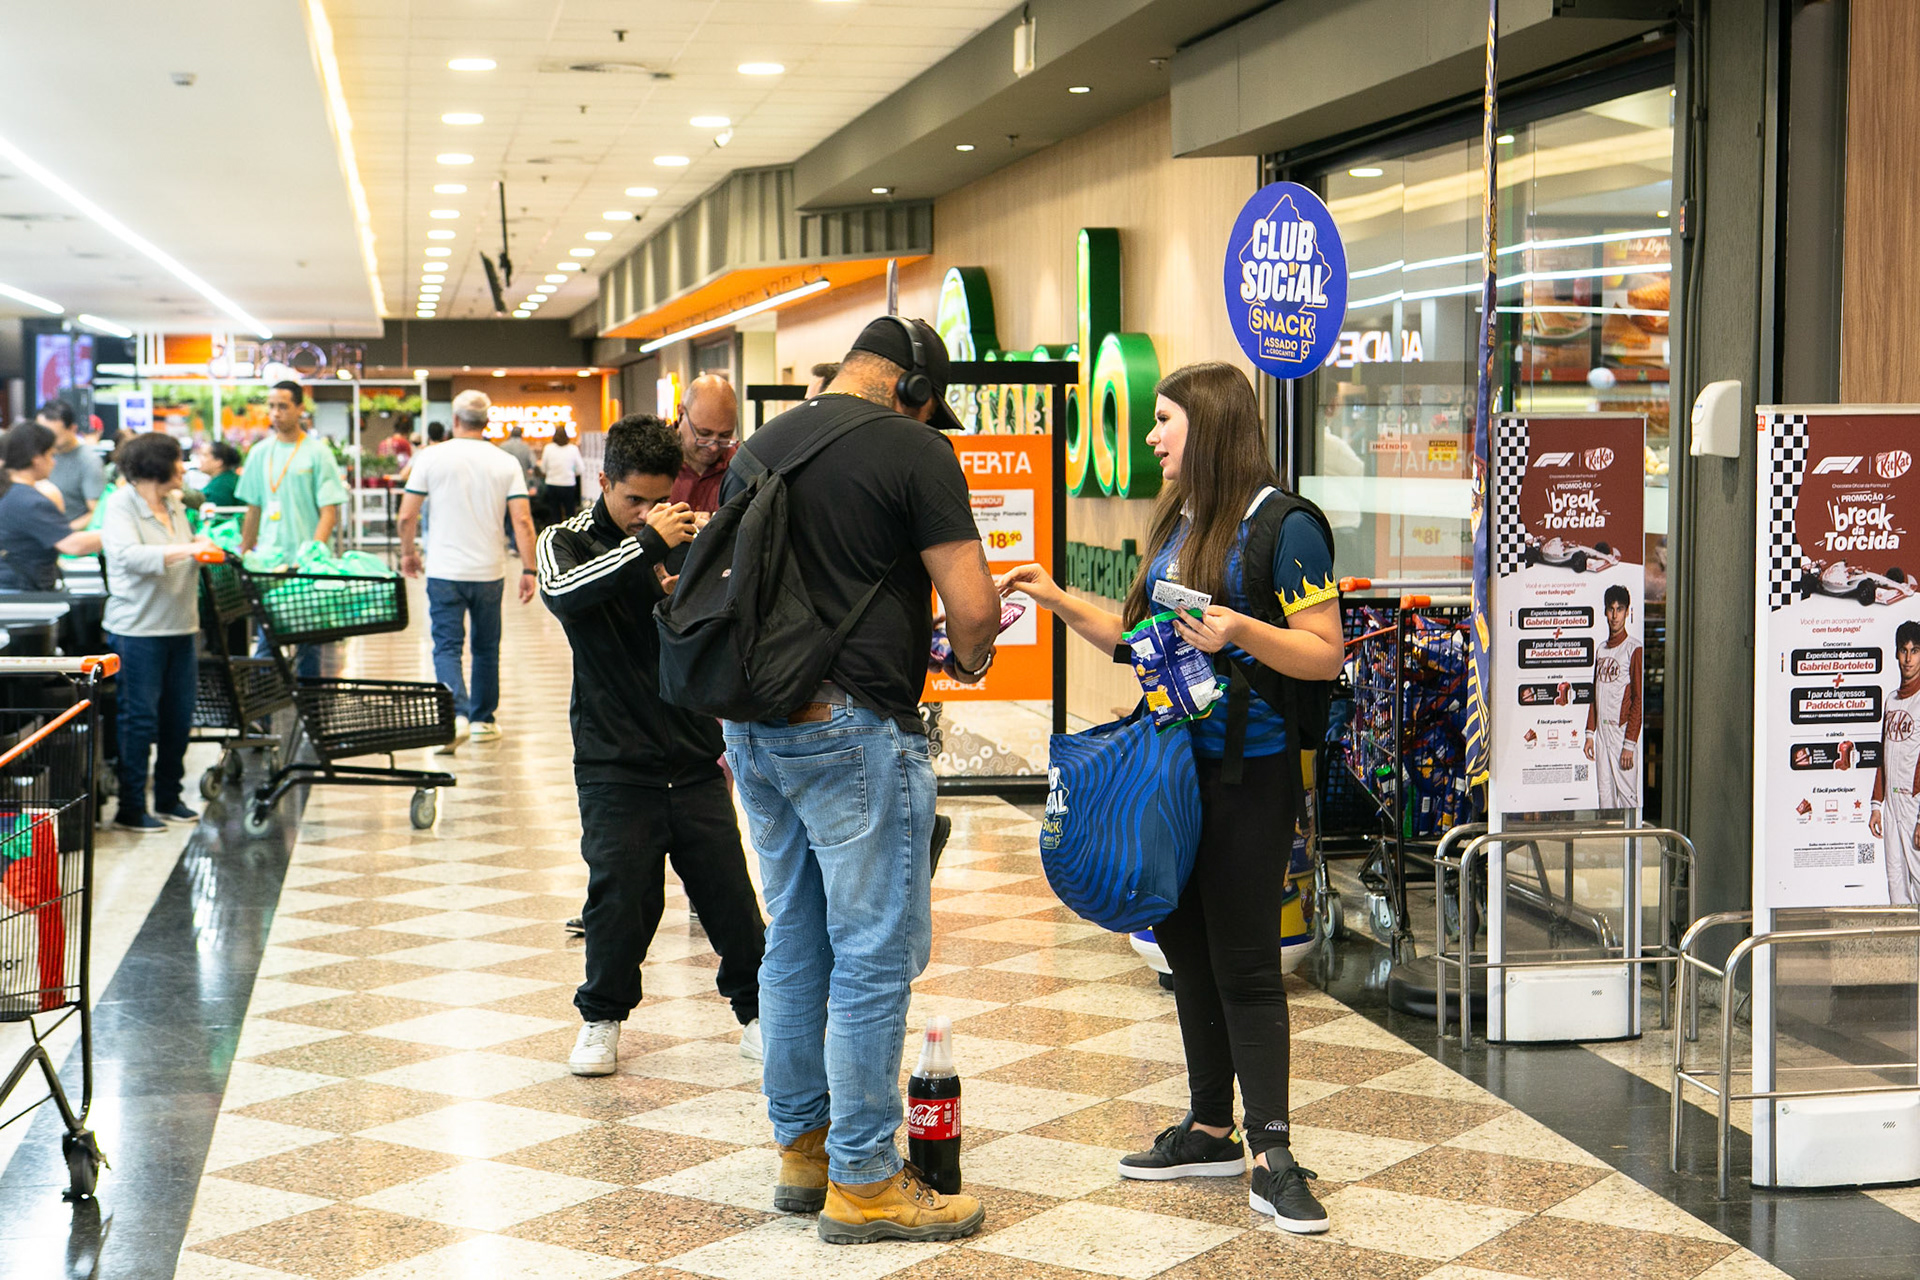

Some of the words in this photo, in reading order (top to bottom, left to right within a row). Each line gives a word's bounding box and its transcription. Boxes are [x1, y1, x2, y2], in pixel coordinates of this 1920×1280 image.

[1252, 220, 1315, 261] CLUB
[1251, 308, 1313, 339] SNACK
[1263, 337, 1298, 351] ASSADO
[960, 451, 1032, 475] FERTA
[1533, 452, 1574, 468] F1
[1587, 447, 1612, 471] KitKat
[1811, 456, 1864, 475] F1
[1879, 449, 1911, 478] KitKat
[1556, 482, 1592, 490] PROMOÇÃO
[1550, 490, 1600, 513] break
[1841, 493, 1884, 503] PROMOÇÃO
[1565, 508, 1577, 516] da
[1833, 503, 1894, 531] break
[1544, 513, 1606, 529] Torcida
[1851, 525, 1865, 535] da
[1824, 531, 1900, 551] Torcida
[1525, 618, 1552, 626] Gabriel
[1553, 617, 1587, 625] Bortoleto
[1800, 617, 1815, 625] Você
[1832, 617, 1875, 625] acompanhante
[1843, 625, 1861, 634] pago!
[1554, 641, 1581, 649] ingressos
[1530, 649, 1563, 657] Paddock
[1805, 651, 1838, 660] Experiência
[1838, 651, 1855, 659] épica
[1800, 662, 1832, 672] Gabriel
[1832, 660, 1874, 671] Bortoleto
[931, 677, 987, 691] VERDADE
[1811, 691, 1824, 700] par
[1824, 690, 1832, 698] de
[1833, 689, 1867, 699] ingressos
[1805, 701, 1845, 710] Paddock
[1885, 710, 1912, 741] KitKat
[908, 1104, 942, 1127] Cola
